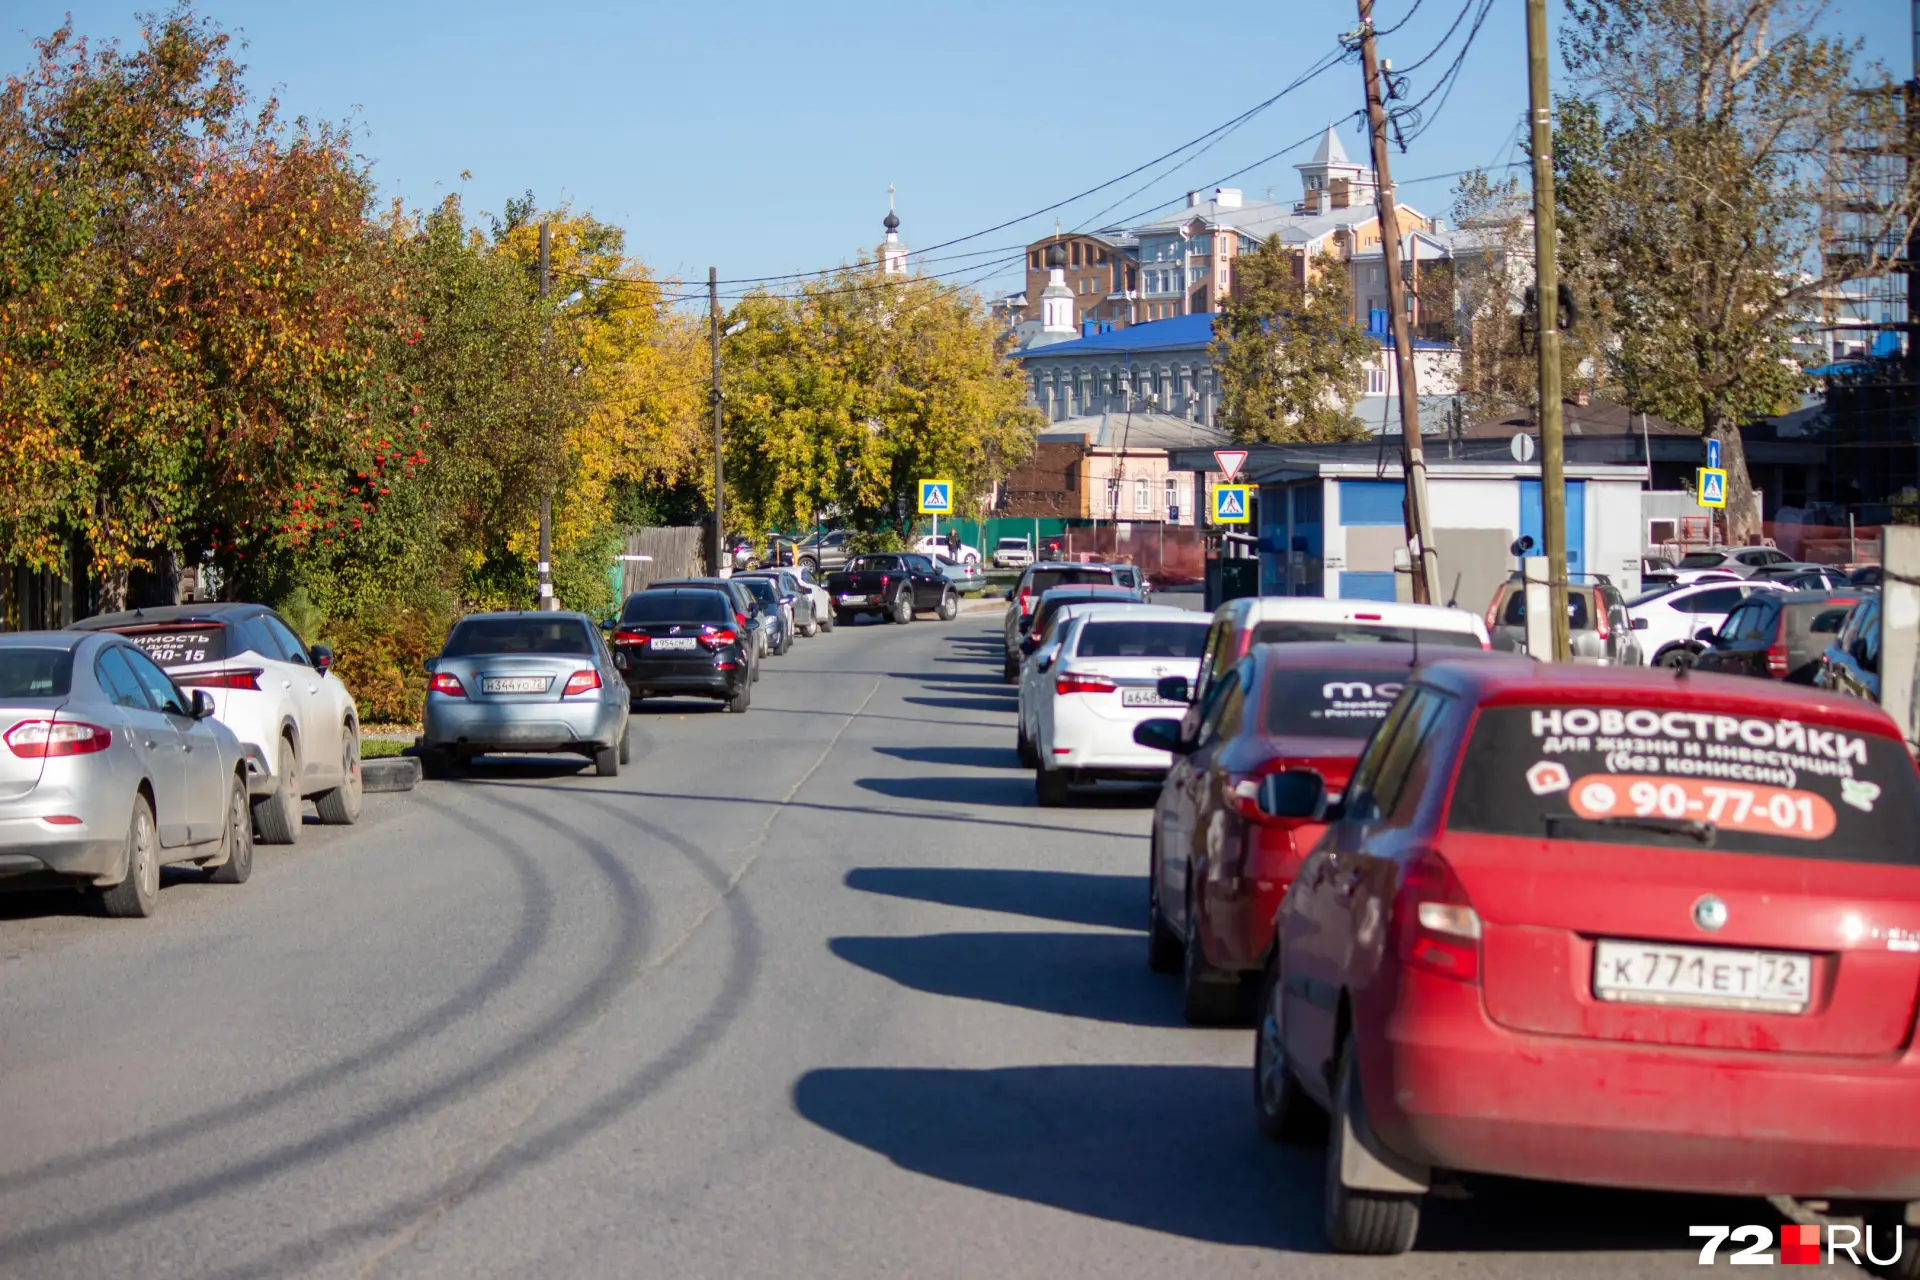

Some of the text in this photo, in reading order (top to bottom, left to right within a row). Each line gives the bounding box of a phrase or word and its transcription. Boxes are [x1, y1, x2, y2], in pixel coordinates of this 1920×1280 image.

[130, 635, 210, 645] ИМОСТЬ
[1530, 708, 1867, 764] НОВОСТРОЙКИ
[1542, 736, 1854, 778] для жизни и инвестиций
[1605, 751, 1797, 788] (без комиссии)
[1628, 781, 1814, 832] 90-77-01
